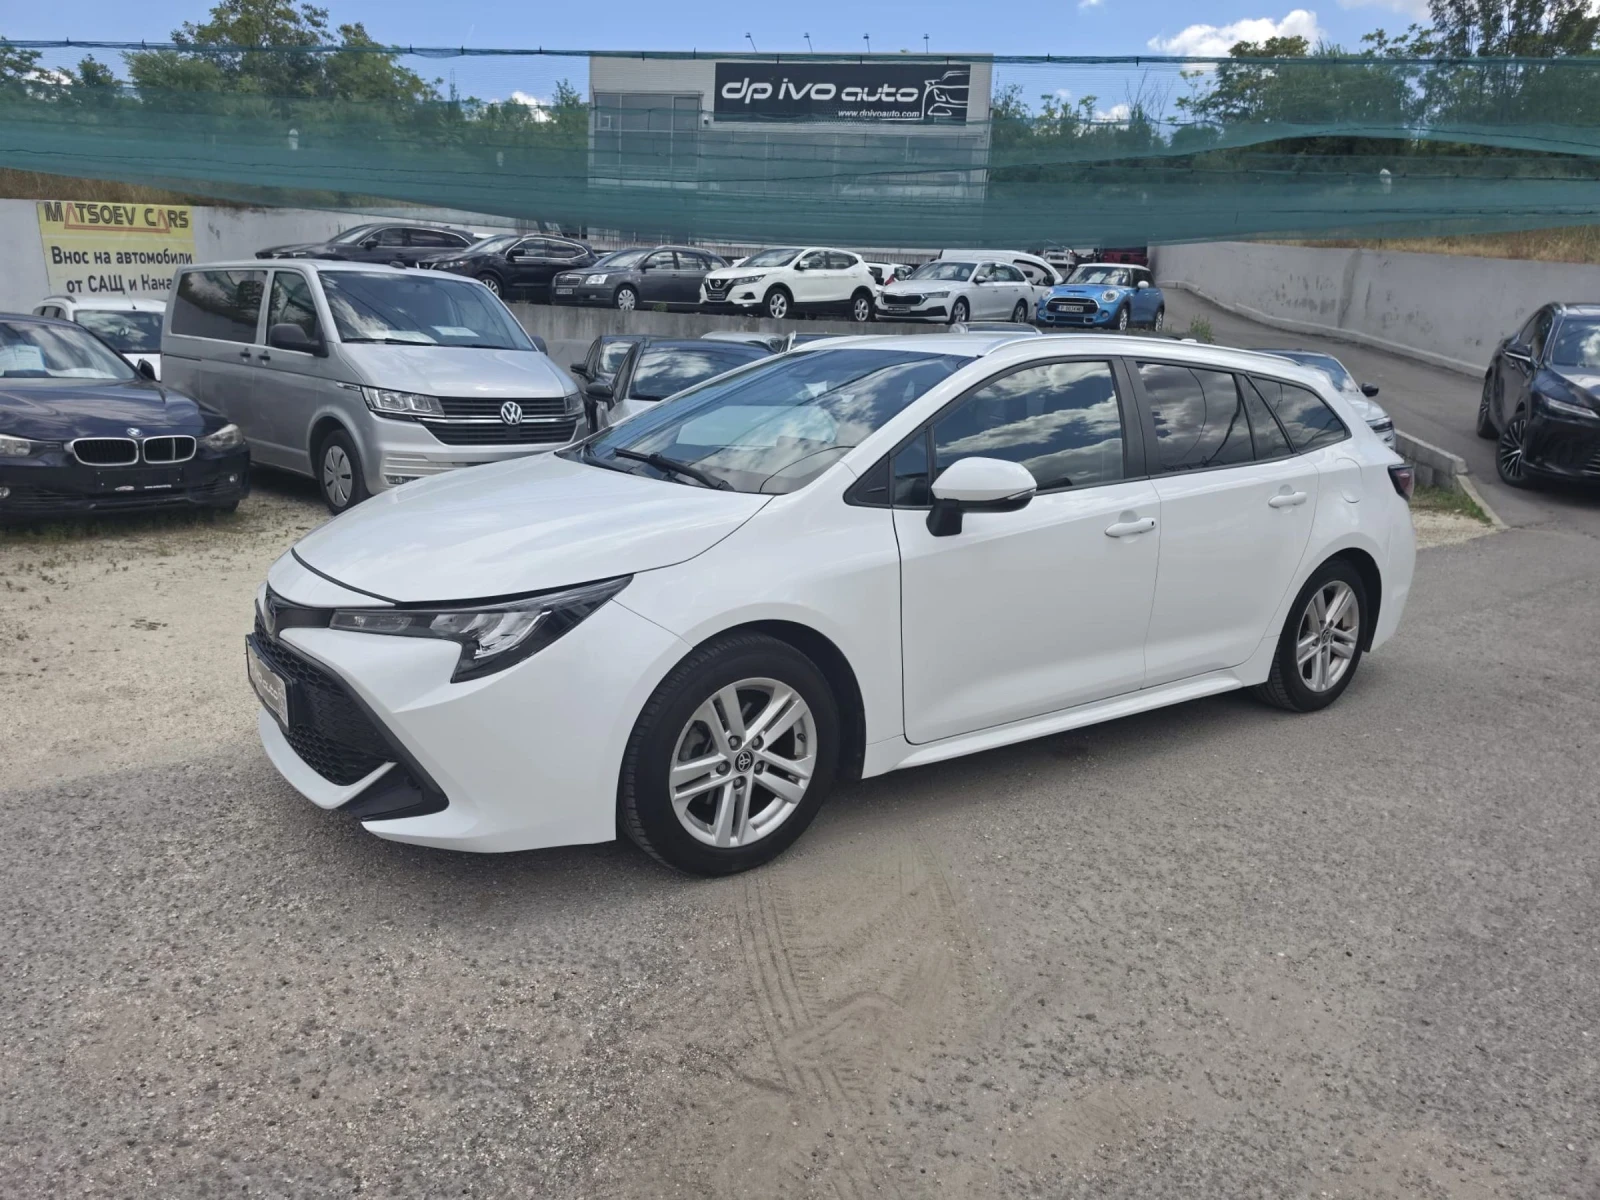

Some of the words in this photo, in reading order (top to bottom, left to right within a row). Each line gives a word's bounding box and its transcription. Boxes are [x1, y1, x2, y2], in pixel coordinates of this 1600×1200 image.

[721, 77, 773, 104] dp
[778, 78, 837, 101] ivo
[841, 83, 919, 102] auto
[44, 201, 136, 227] MATSOEV
[144, 208, 189, 230] CARS
[51, 246, 90, 265] Внос
[93, 251, 112, 265] на
[116, 247, 193, 265] автомобили
[66, 279, 83, 293] от
[87, 274, 126, 295] САЩ
[128, 278, 138, 291] и
